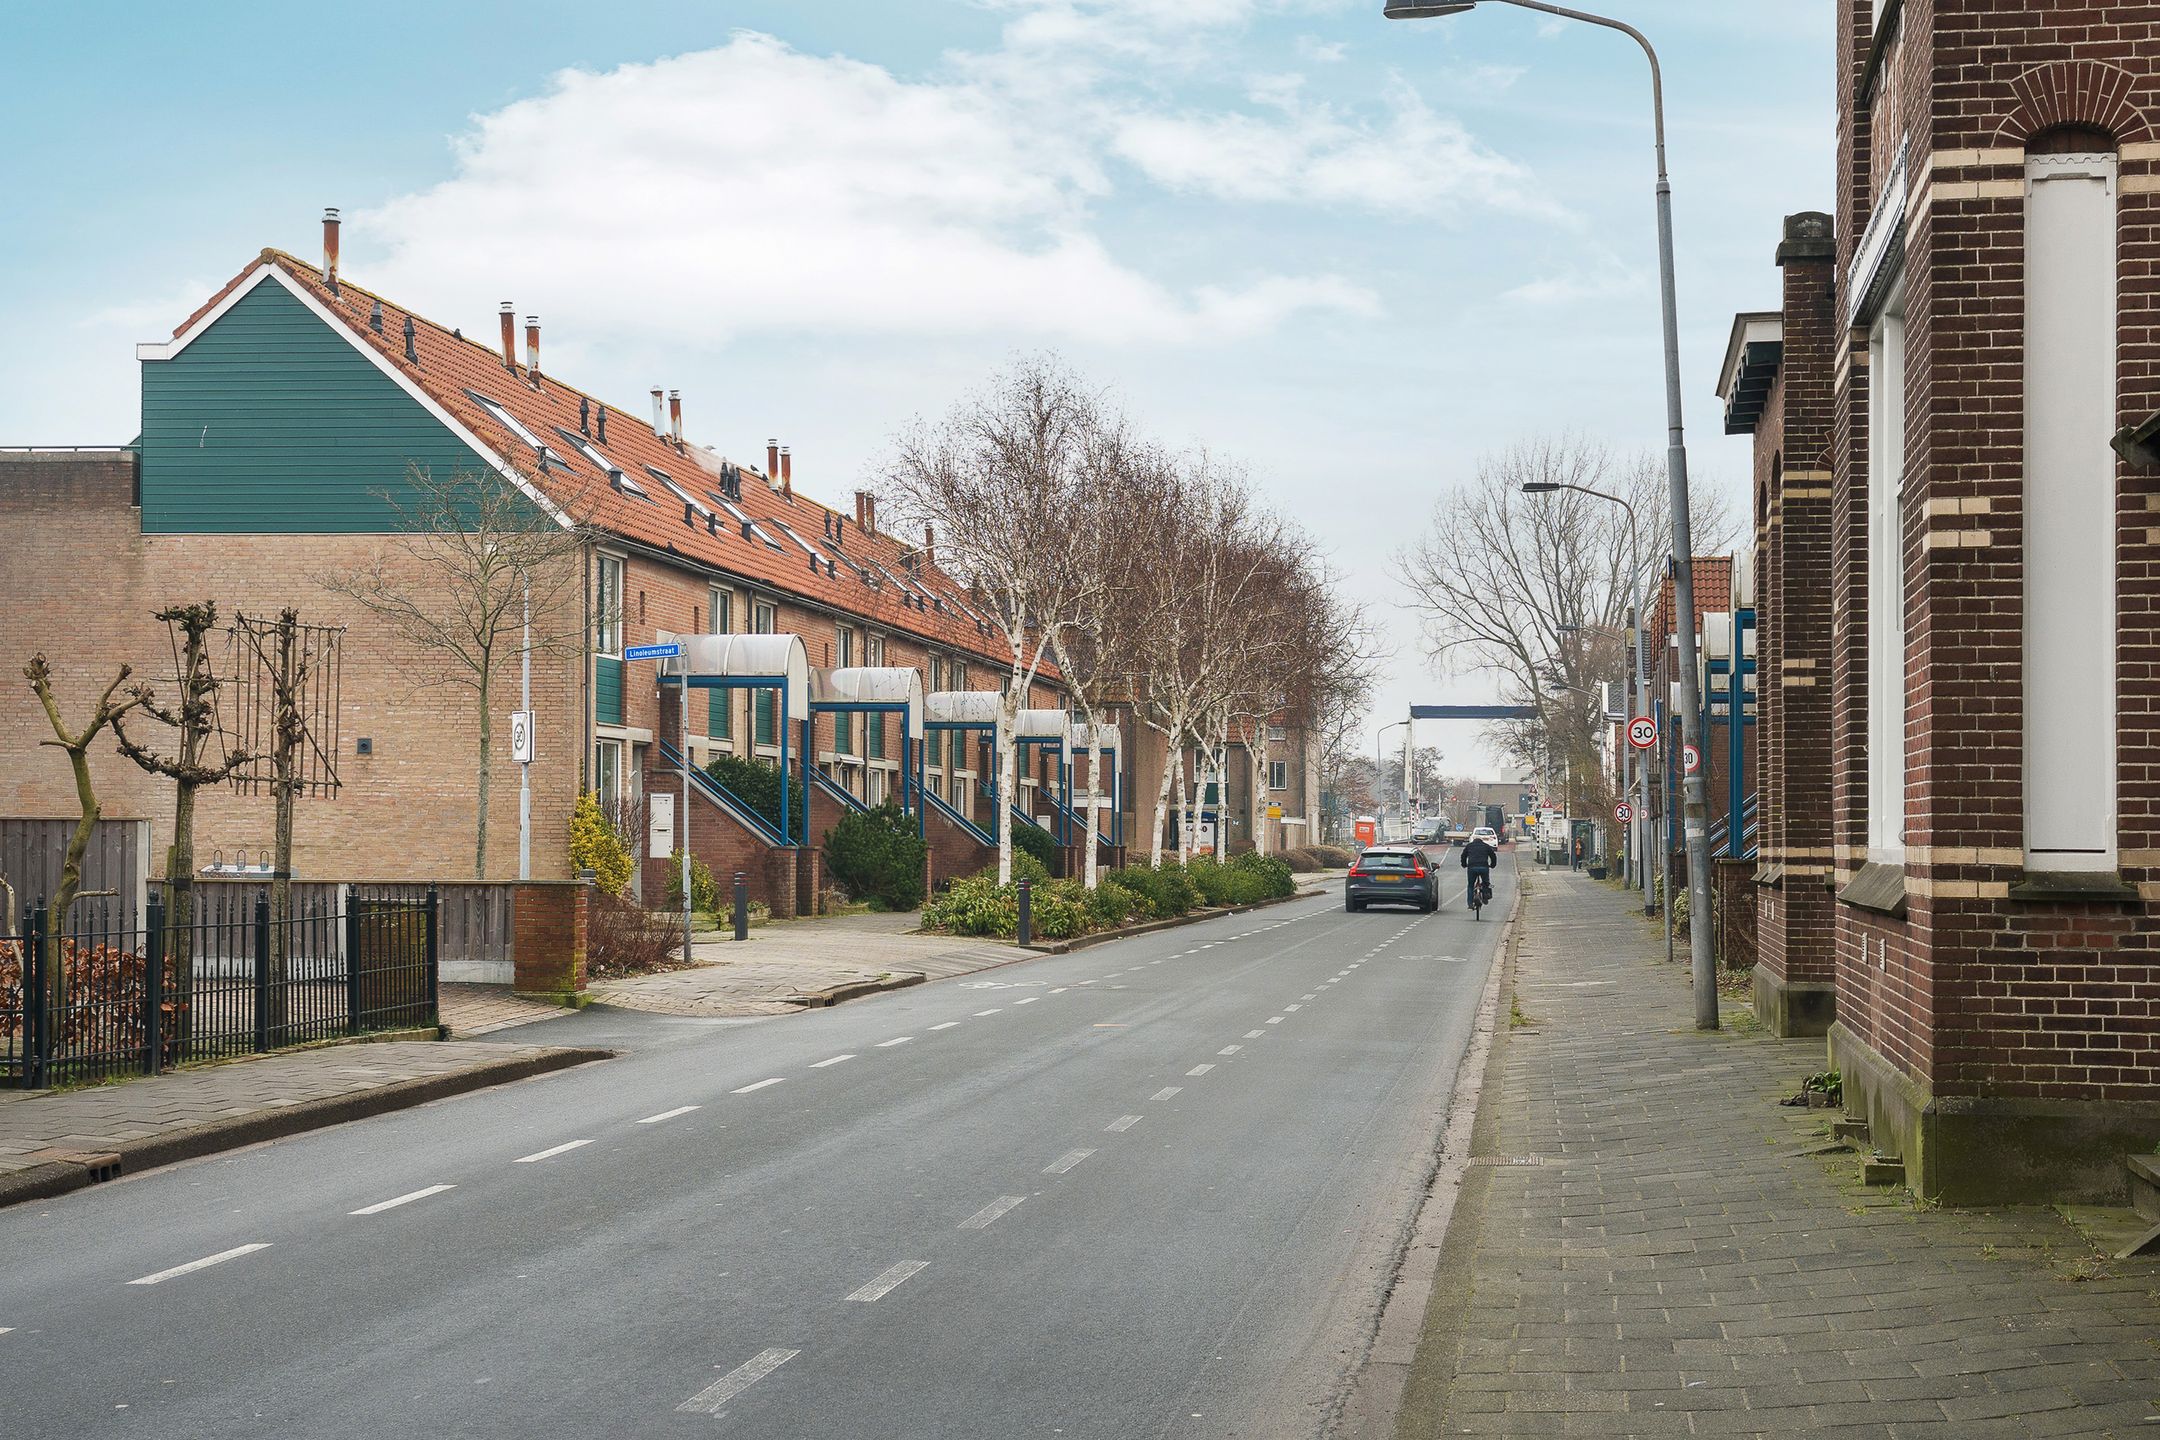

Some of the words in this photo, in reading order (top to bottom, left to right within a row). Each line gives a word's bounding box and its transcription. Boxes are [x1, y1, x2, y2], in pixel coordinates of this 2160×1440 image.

[629, 647, 675, 657] Linoleumstraat
[1633, 727, 1653, 738] 30
[1618, 807, 1630, 818] 30
